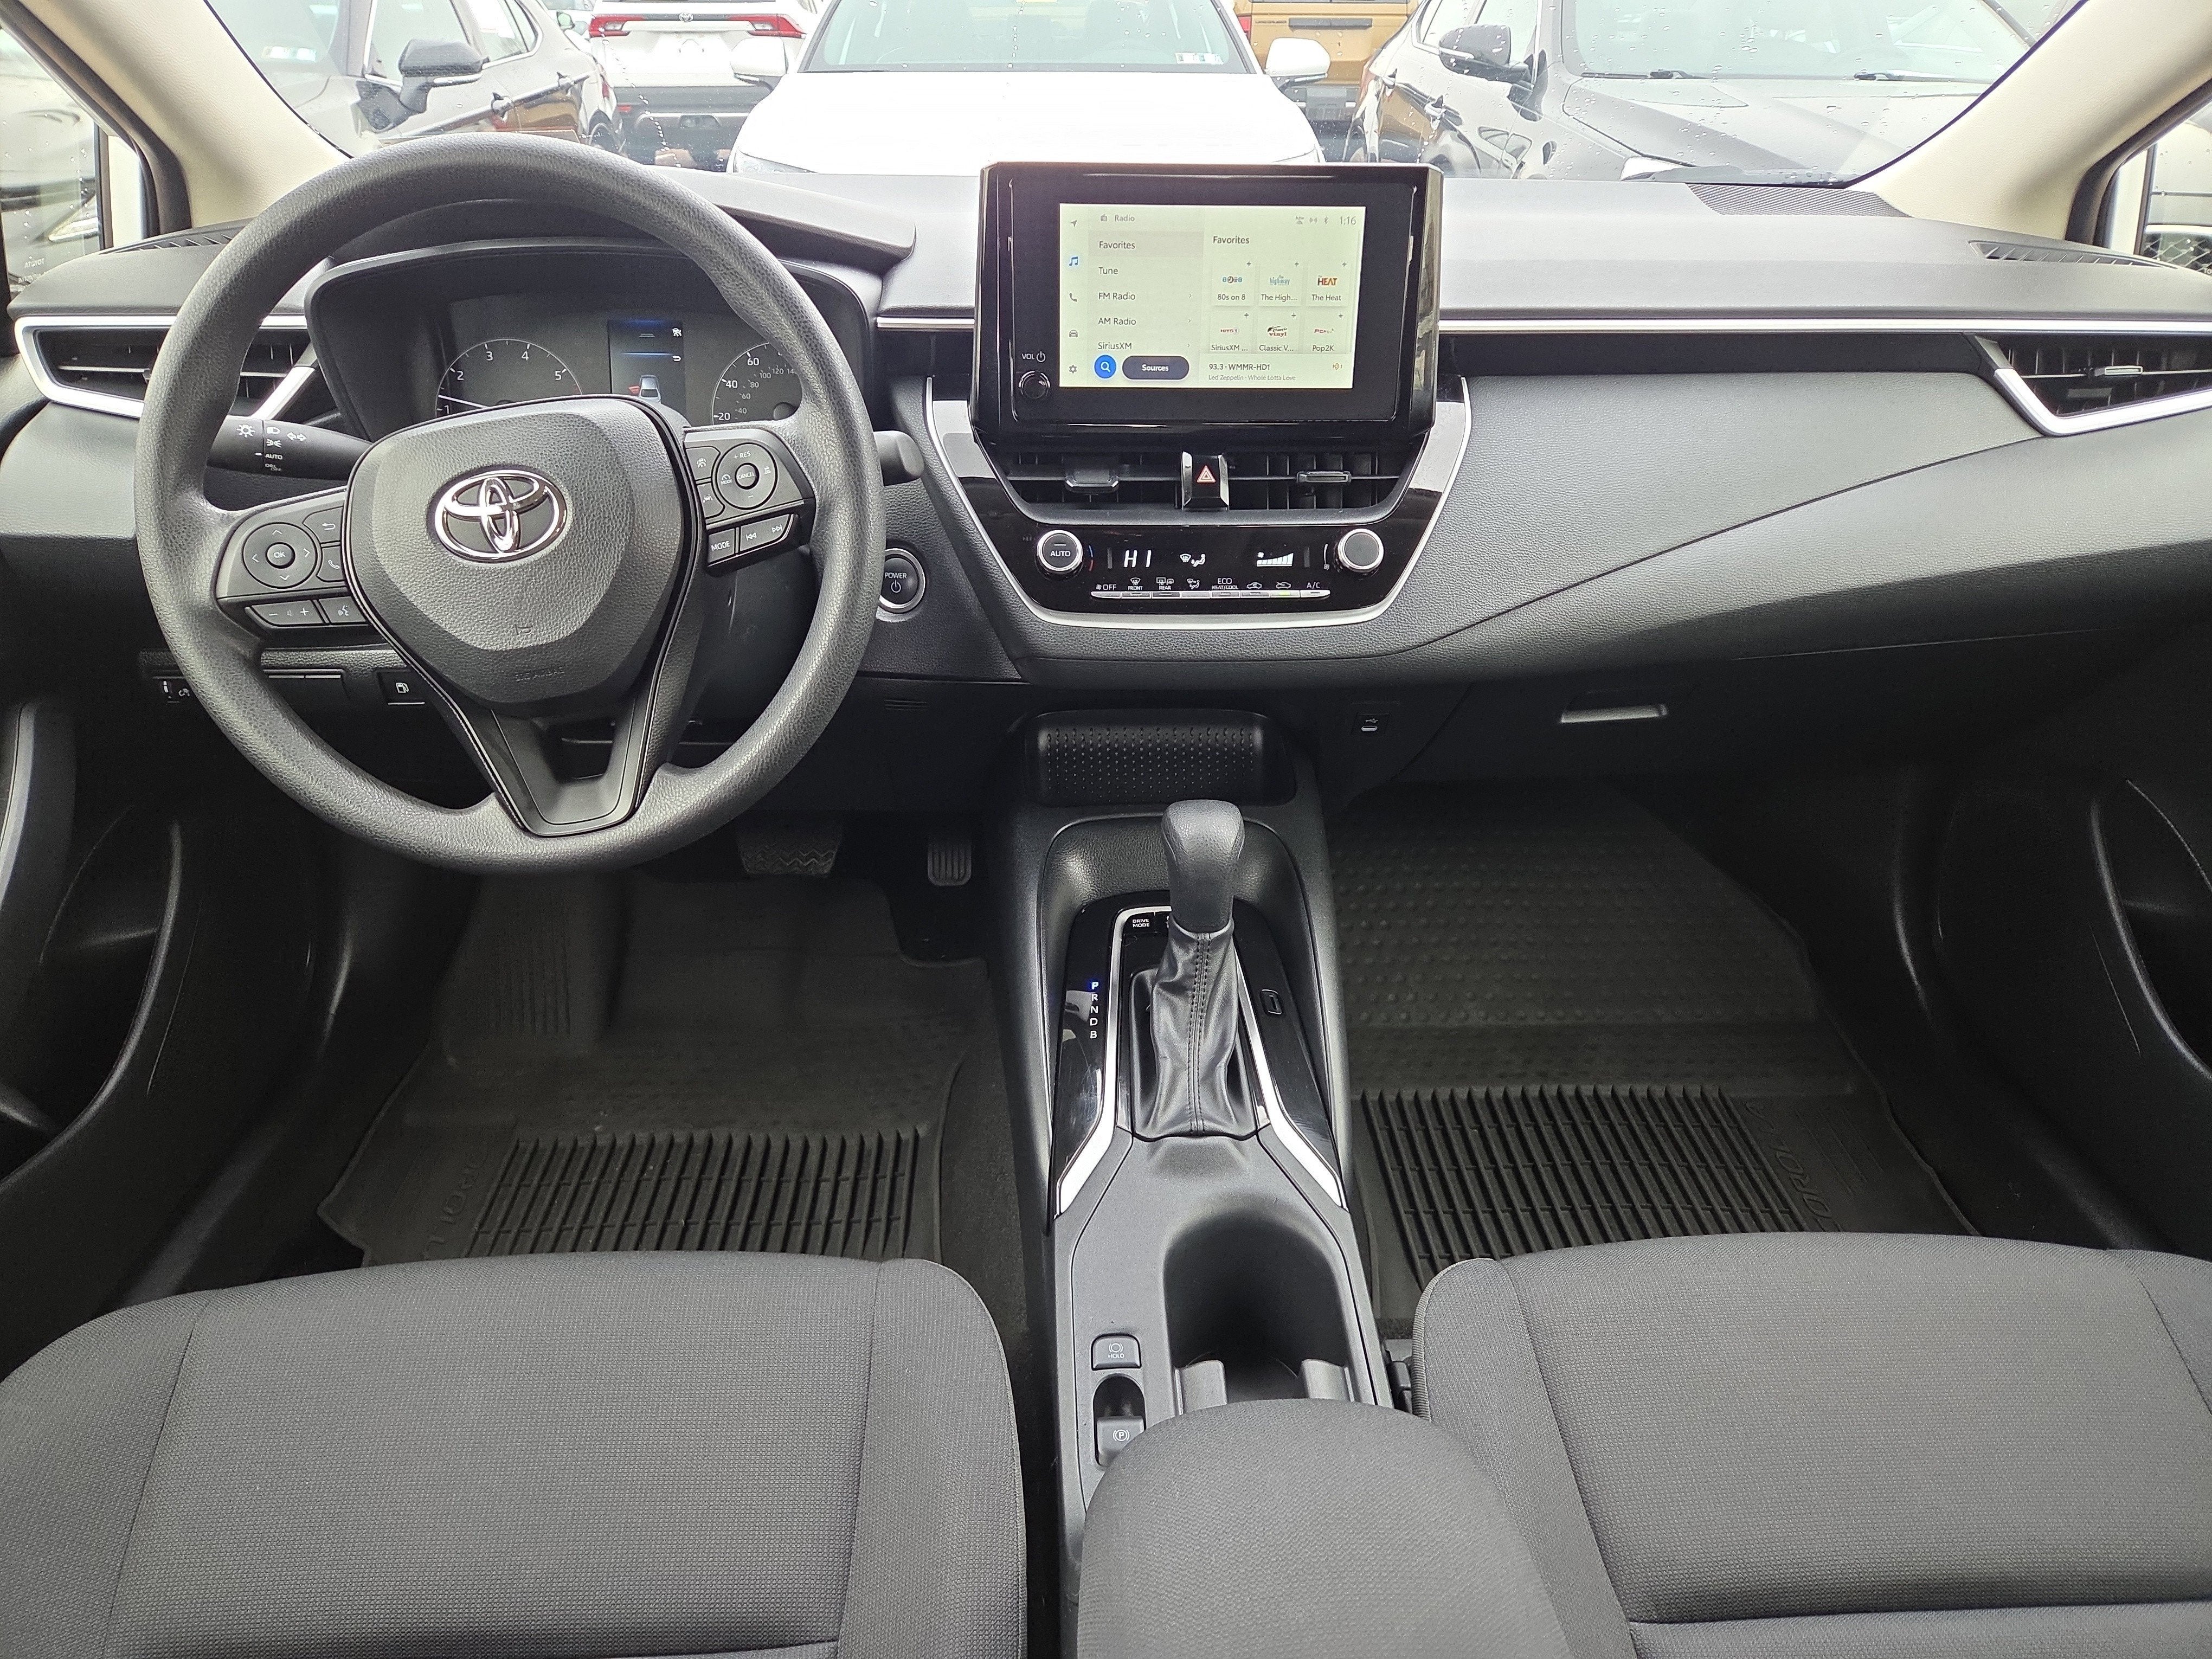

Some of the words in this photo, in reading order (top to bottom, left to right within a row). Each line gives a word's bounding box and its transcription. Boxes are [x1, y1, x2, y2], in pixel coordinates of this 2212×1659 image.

[1339, 216, 1356, 225] 1:16
[1213, 235, 1250, 244] Favorites
[1099, 240, 1135, 249] Favorites
[1098, 292, 1110, 300] FM
[1113, 292, 1136, 300] Radio
[1098, 317, 1111, 325] AM
[1113, 317, 1136, 325] Radio
[1097, 342, 1133, 350] SiriusXM
[1312, 345, 1334, 353] Pop2K
[486, 351, 493, 361] 3
[521, 351, 530, 361] 4
[747, 357, 760, 366] 60
[456, 370, 464, 381] 2
[555, 370, 562, 381] 5
[725, 380, 738, 388] 40
[444, 405, 449, 414] 1
[718, 412, 730, 421] 20
[740, 451, 751, 459] RES
[711, 540, 731, 551] MODE
[1091, 981, 1099, 990] P
[1091, 993, 1098, 1002] R
[1090, 1005, 1098, 1014] N
[1090, 1018, 1098, 1026] D
[1090, 1030, 1097, 1039] B
